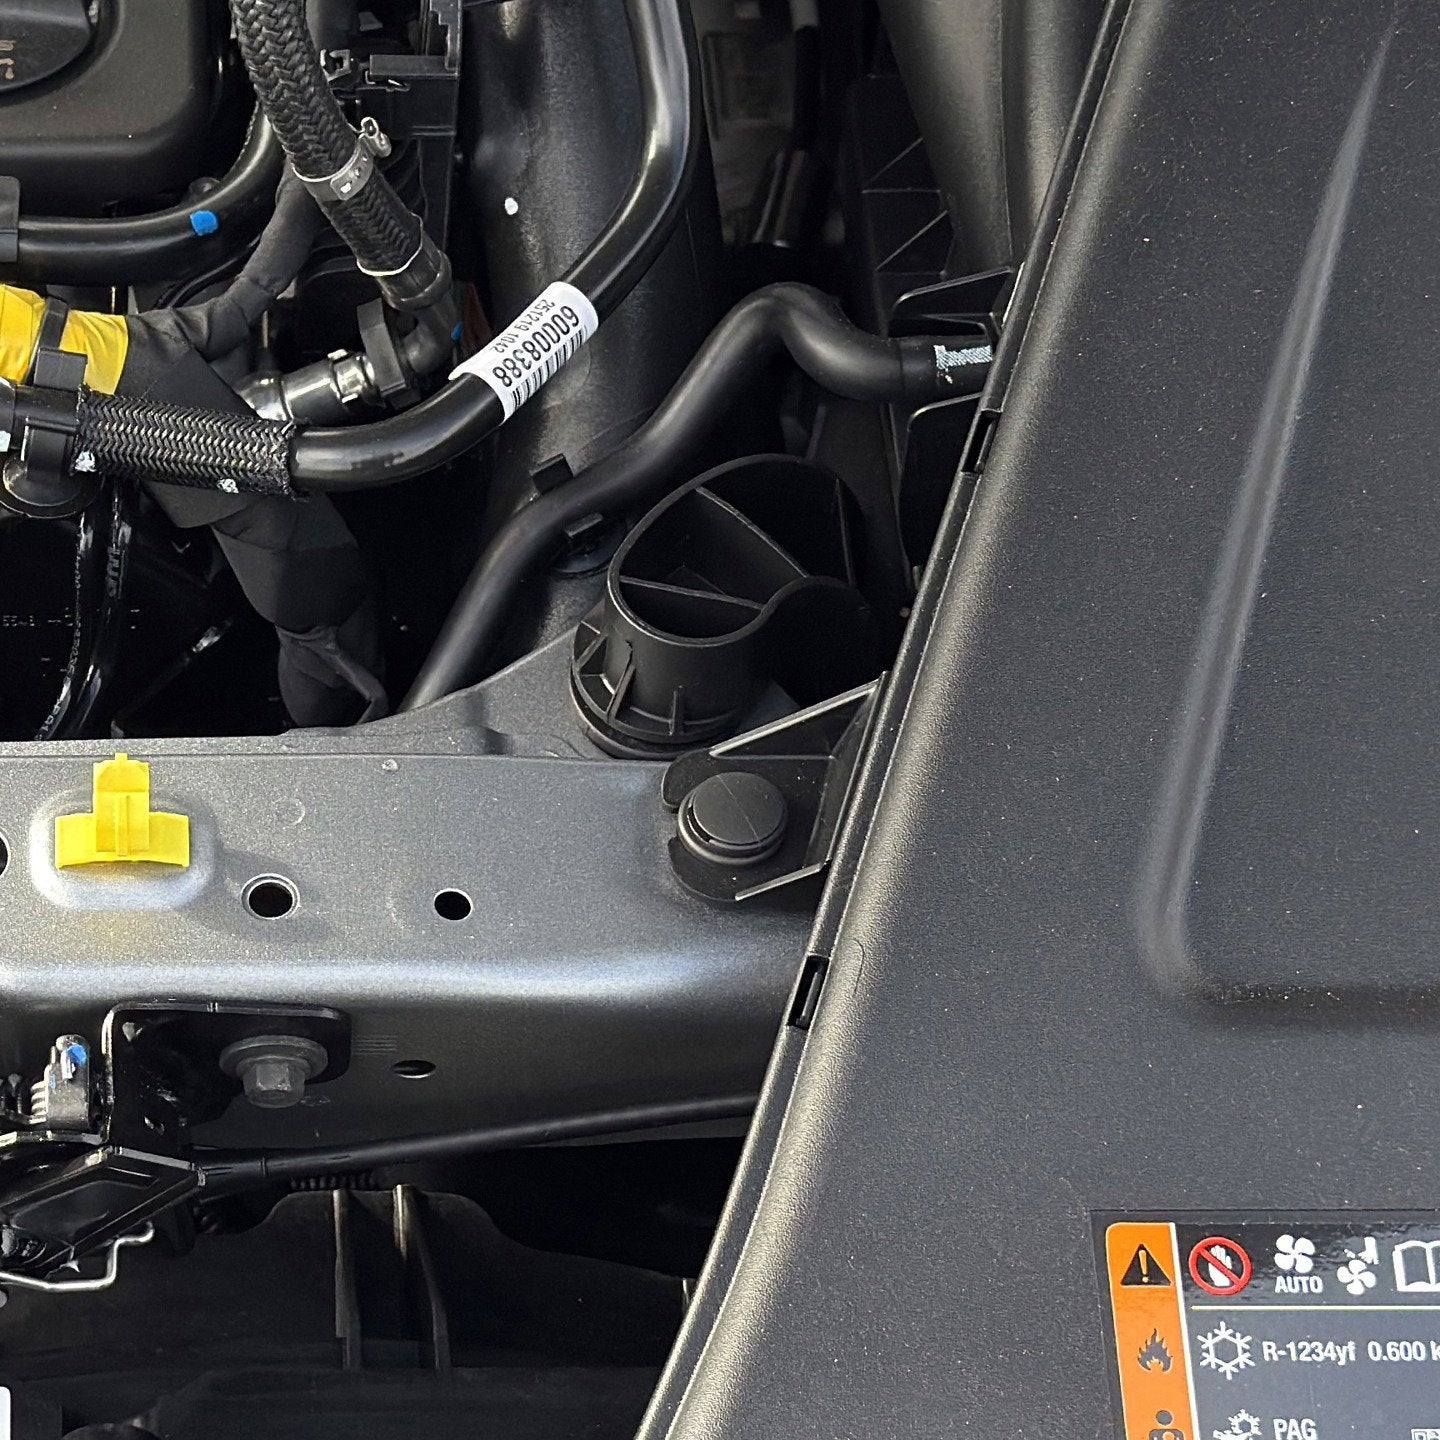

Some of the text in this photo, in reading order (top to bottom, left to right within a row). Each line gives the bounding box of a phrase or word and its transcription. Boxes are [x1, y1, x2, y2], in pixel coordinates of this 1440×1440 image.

[493, 305, 581, 388] 60008388
[1274, 1275, 1324, 1295] AUTO
[1262, 1341, 1356, 1367] R-1234yf
[1367, 1341, 1426, 1362] 0.600
